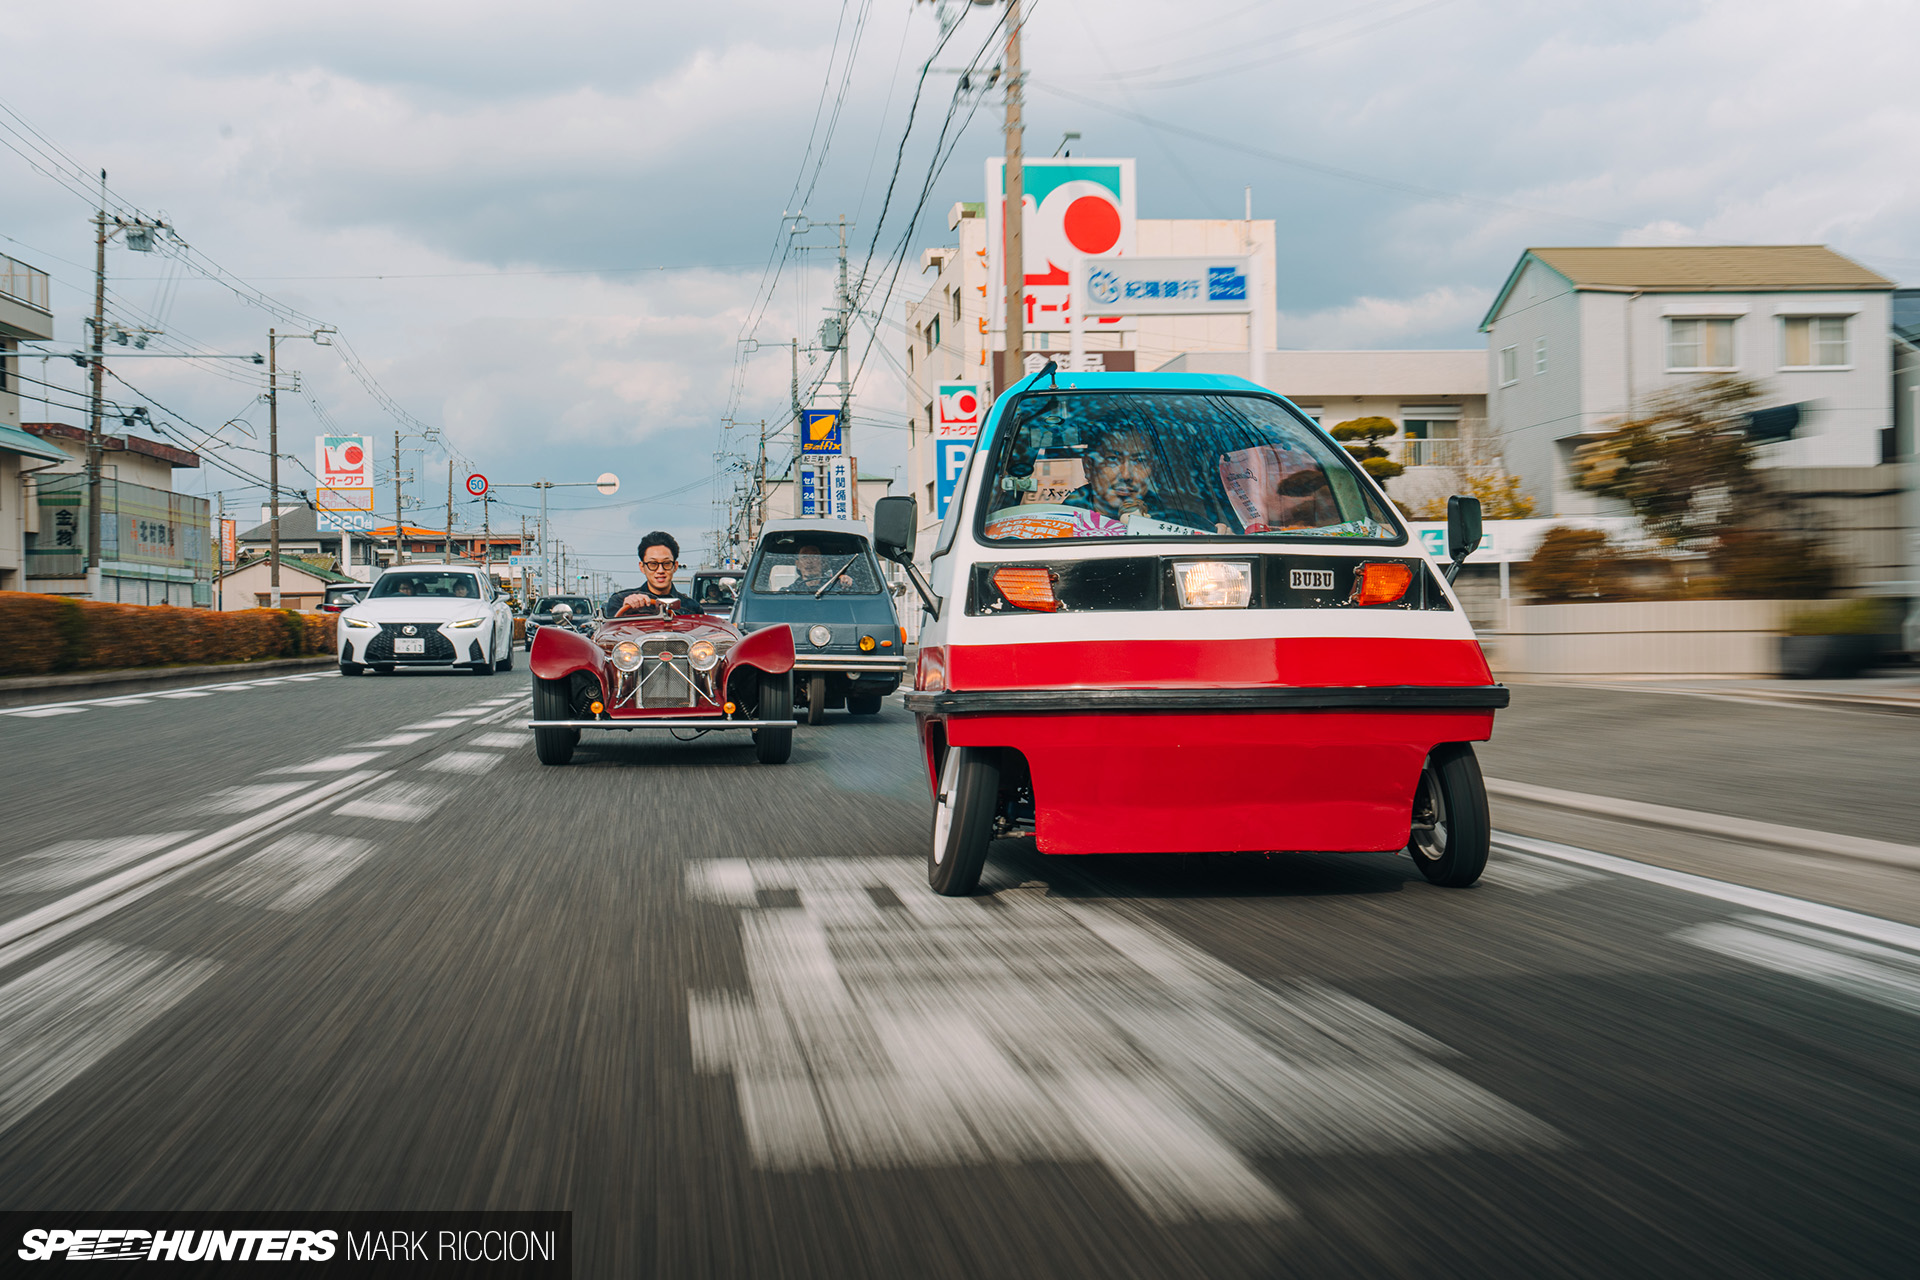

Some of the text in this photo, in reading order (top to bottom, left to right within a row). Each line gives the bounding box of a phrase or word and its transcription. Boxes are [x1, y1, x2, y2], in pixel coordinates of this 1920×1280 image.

[325, 476, 364, 486] オークワ
[470, 479, 484, 490] 50
[1292, 571, 1333, 587] BUBU
